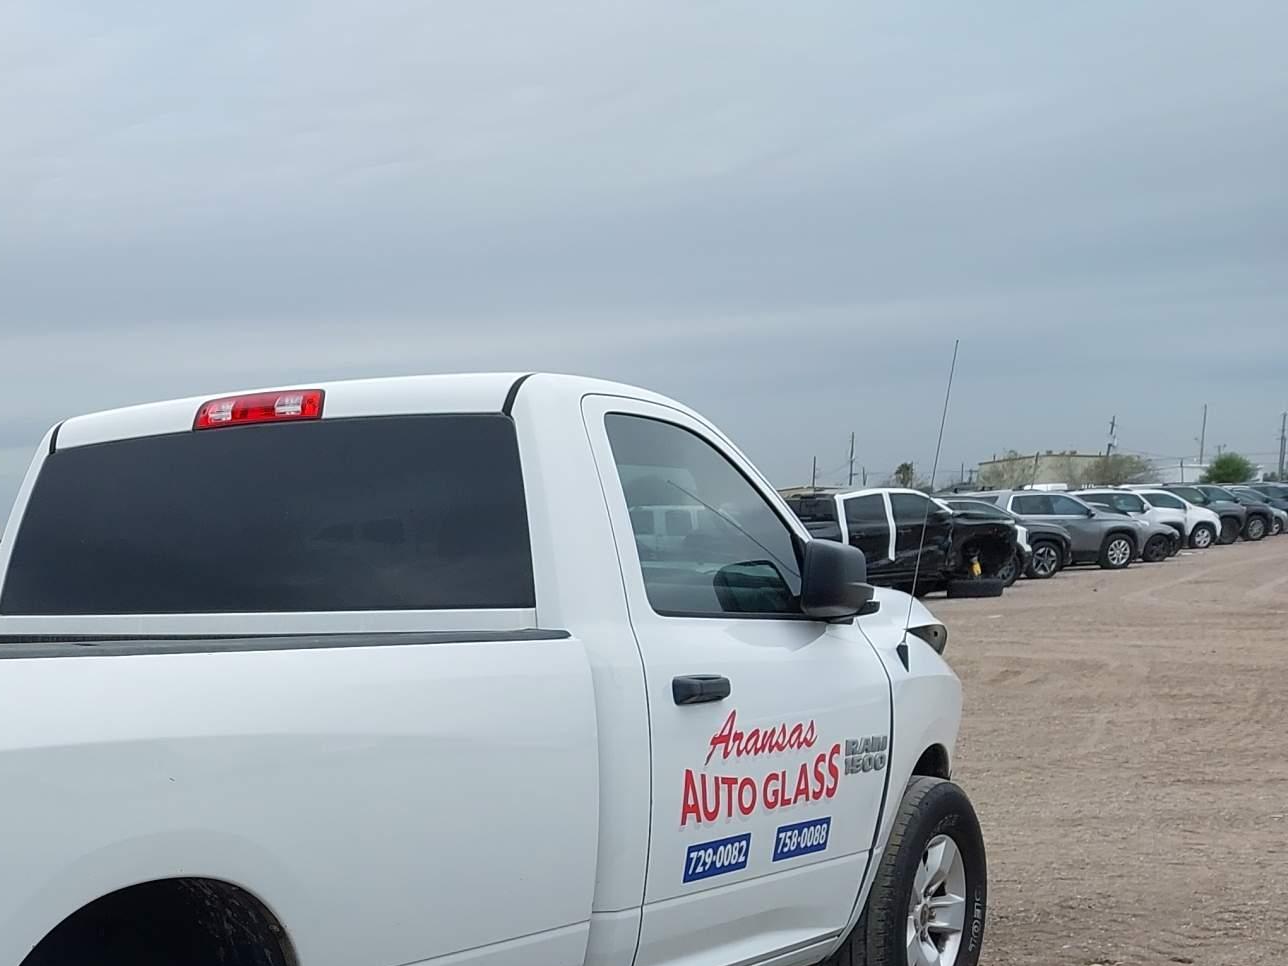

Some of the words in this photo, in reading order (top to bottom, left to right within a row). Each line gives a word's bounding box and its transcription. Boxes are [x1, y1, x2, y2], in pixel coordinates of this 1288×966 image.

[704, 709, 818, 766] Aransas
[845, 736, 888, 756] RAM
[845, 753, 886, 775] 1500
[680, 768, 758, 826] AUTO
[762, 743, 841, 810] GLASS
